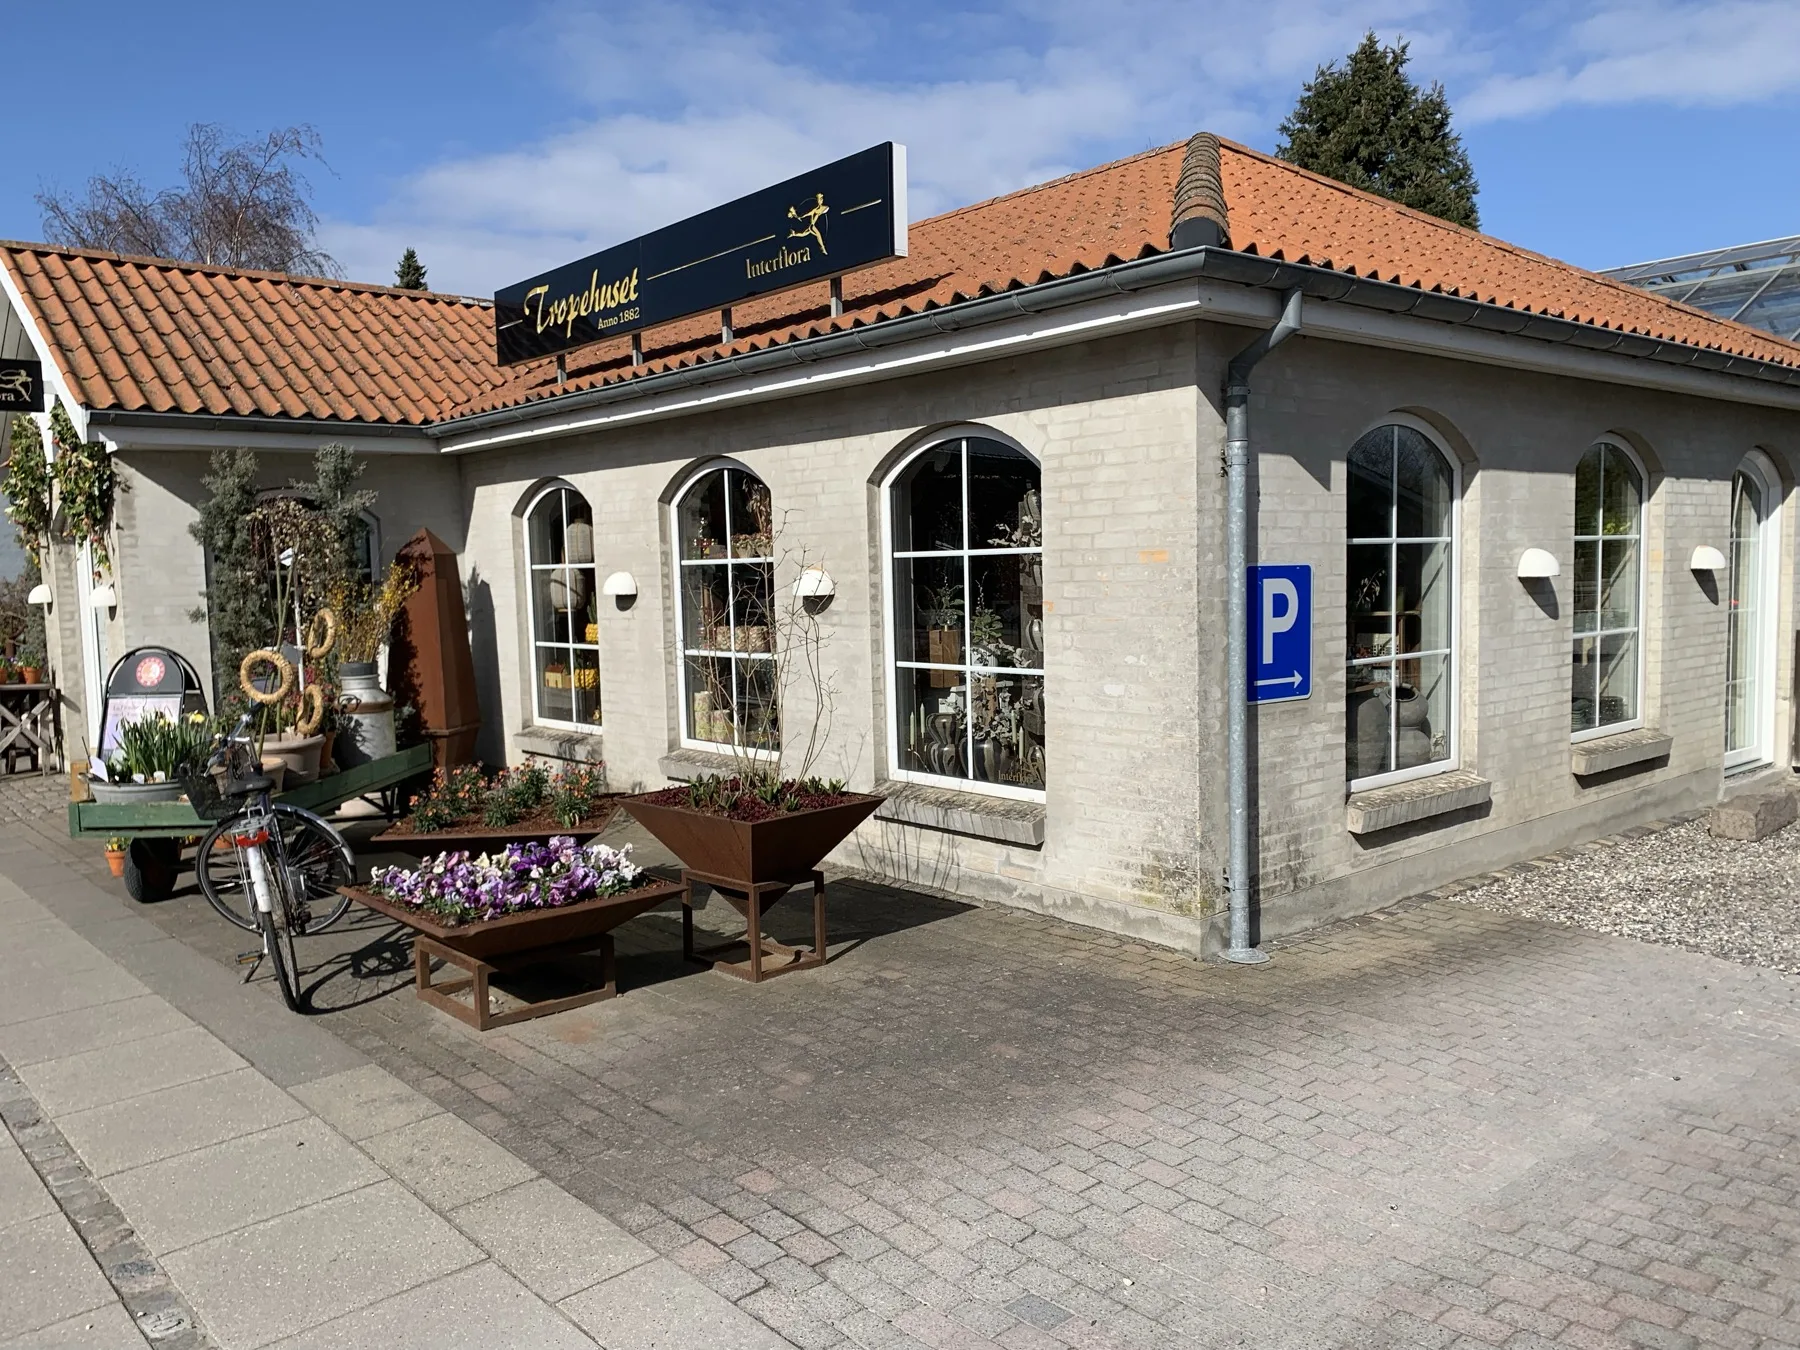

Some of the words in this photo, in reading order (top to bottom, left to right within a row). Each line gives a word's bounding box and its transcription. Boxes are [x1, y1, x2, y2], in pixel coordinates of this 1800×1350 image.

[745, 246, 811, 279] Interflora
[523, 267, 639, 339] Tropehuset
[598, 316, 618, 330] Anno
[619, 307, 640, 323] 1882
[1262, 578, 1299, 665] P
